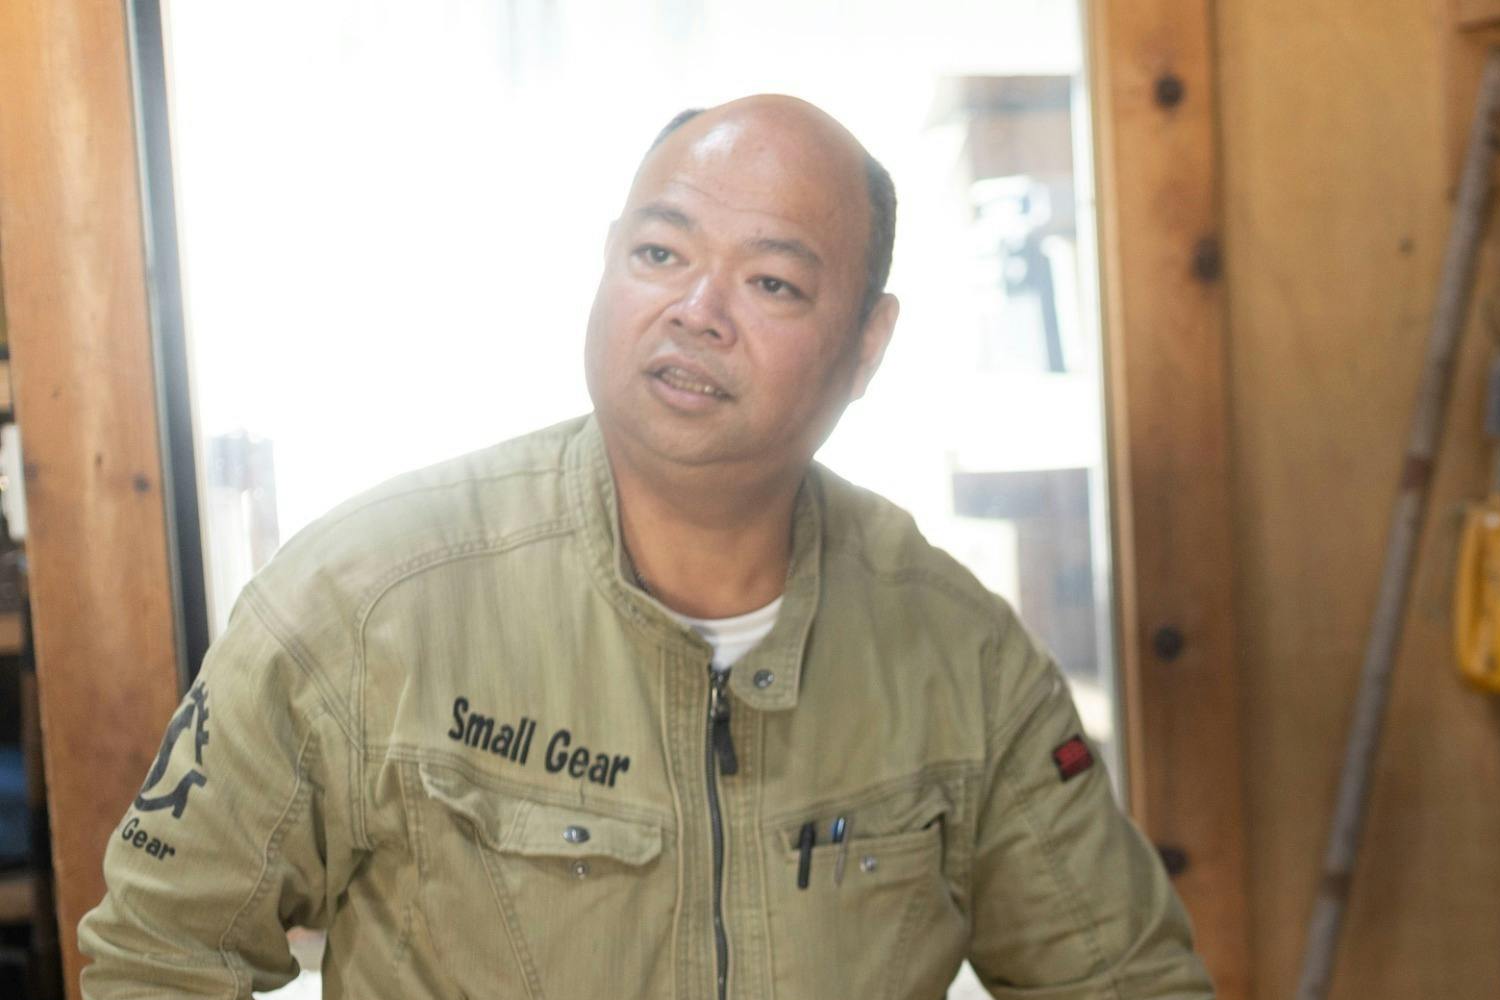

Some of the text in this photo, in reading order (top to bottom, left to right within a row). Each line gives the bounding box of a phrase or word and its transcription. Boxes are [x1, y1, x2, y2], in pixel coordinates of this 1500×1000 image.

[448, 696, 631, 788] Small Gear
[121, 817, 176, 861] Gear
